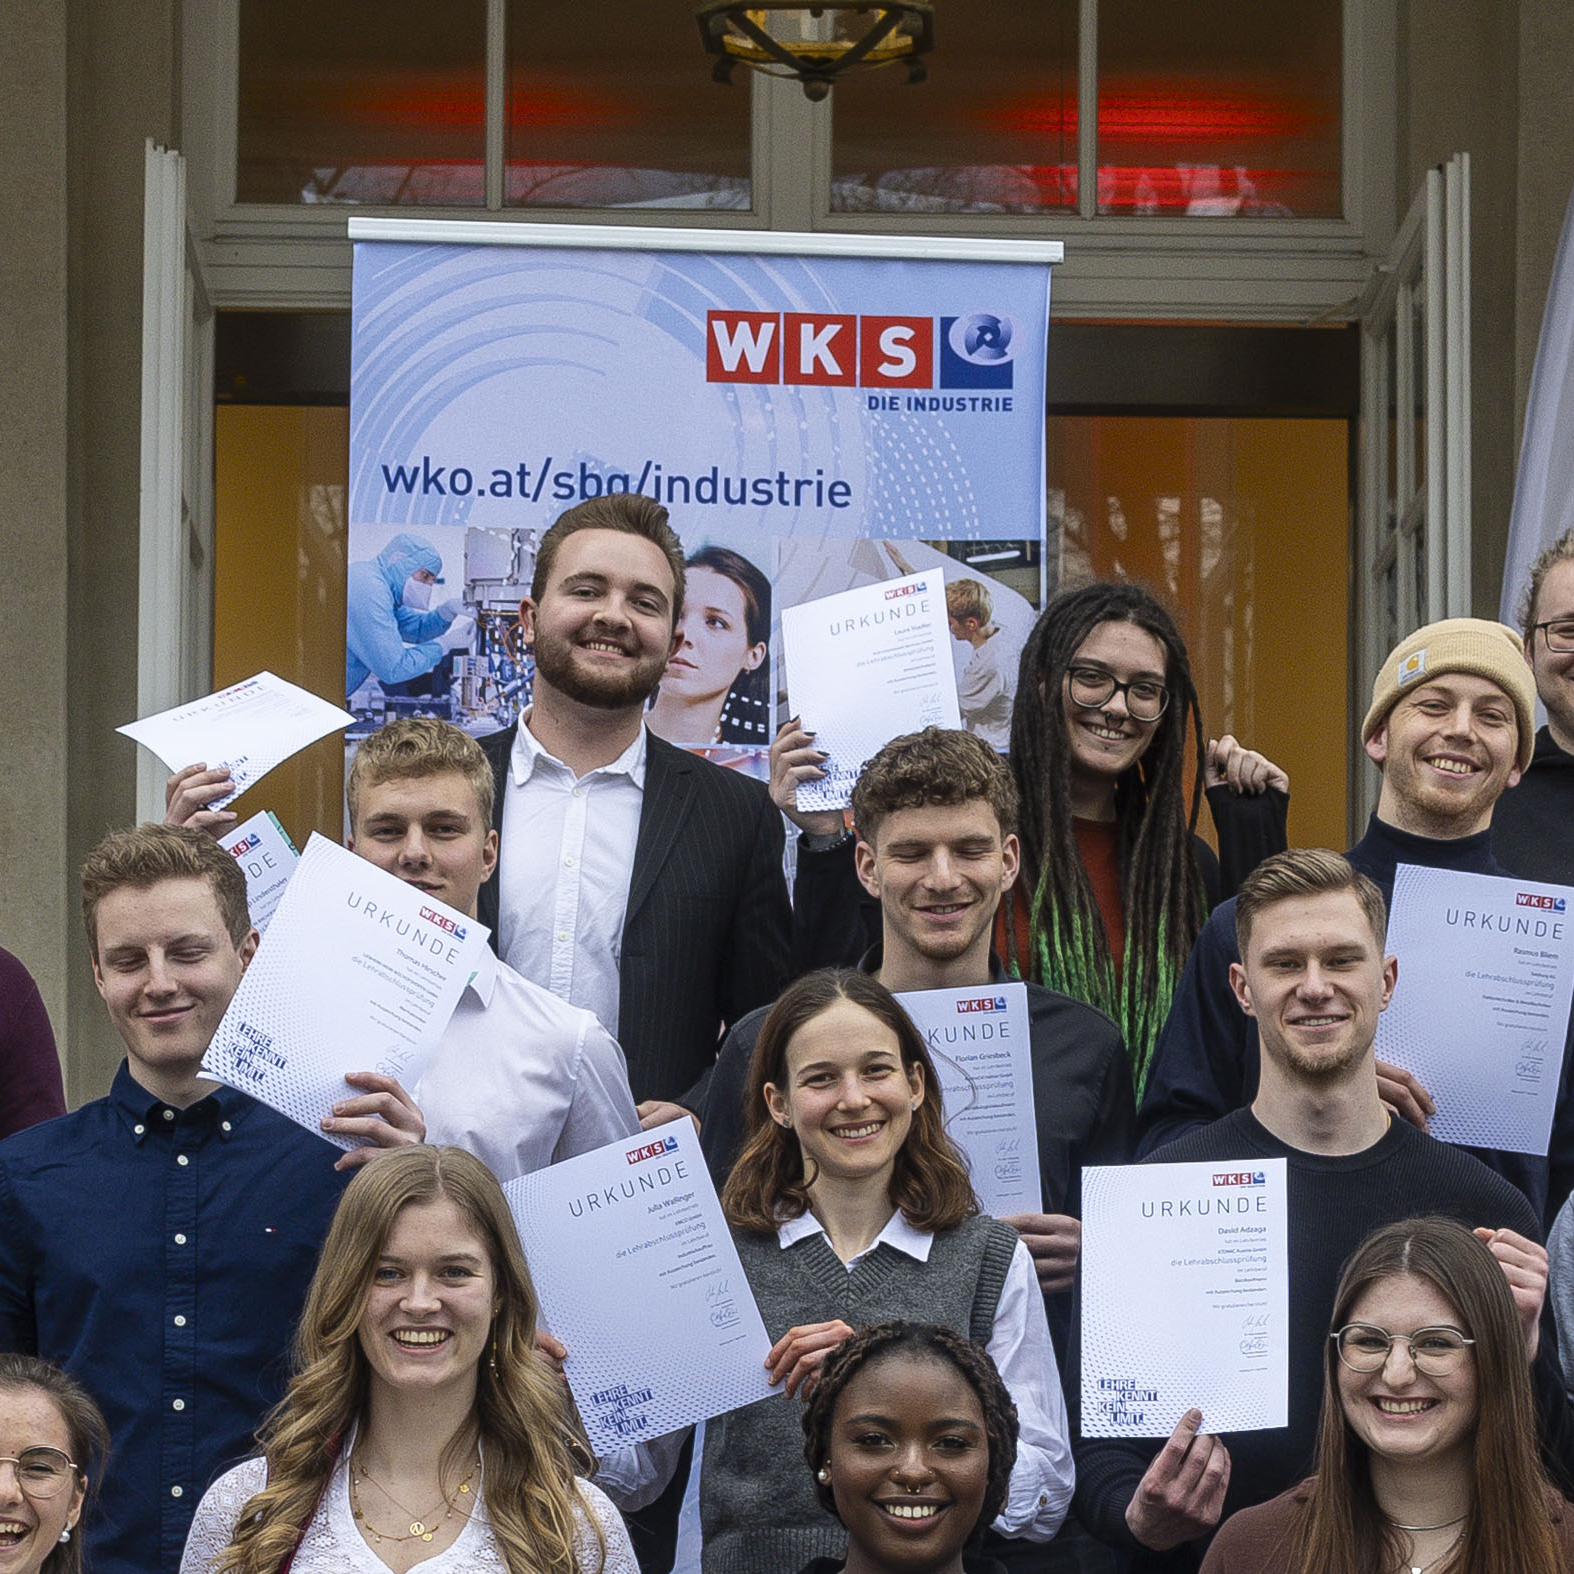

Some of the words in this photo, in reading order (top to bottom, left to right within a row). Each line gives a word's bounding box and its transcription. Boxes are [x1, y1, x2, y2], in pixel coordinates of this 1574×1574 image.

[711, 320, 916, 378] WKS
[868, 395, 899, 411] DIE
[906, 396, 1013, 412] INDUSTRIE
[829, 597, 930, 637] URKUNDE
[1515, 893, 1552, 908] WKS
[345, 890, 459, 965] URKUNDE
[418, 906, 455, 933] WKS
[1445, 907, 1564, 940] URKUNDE
[957, 999, 993, 1013] WKS
[928, 1021, 1010, 1044] KUNDE
[625, 1141, 664, 1164] WKS
[567, 1159, 690, 1218] URKUNDE
[1213, 1173, 1250, 1185] WKS
[1142, 1196, 1266, 1218] URKUNDE
[1218, 1227, 1239, 1235] David
[590, 1383, 629, 1406] LEHRE
[1097, 1378, 1135, 1391] LEHRE
[1116, 1389, 1158, 1402] KENNT
[611, 1387, 654, 1412] KENNT
[1097, 1400, 1126, 1413] KEIN
[599, 1409, 628, 1429] KEIN
